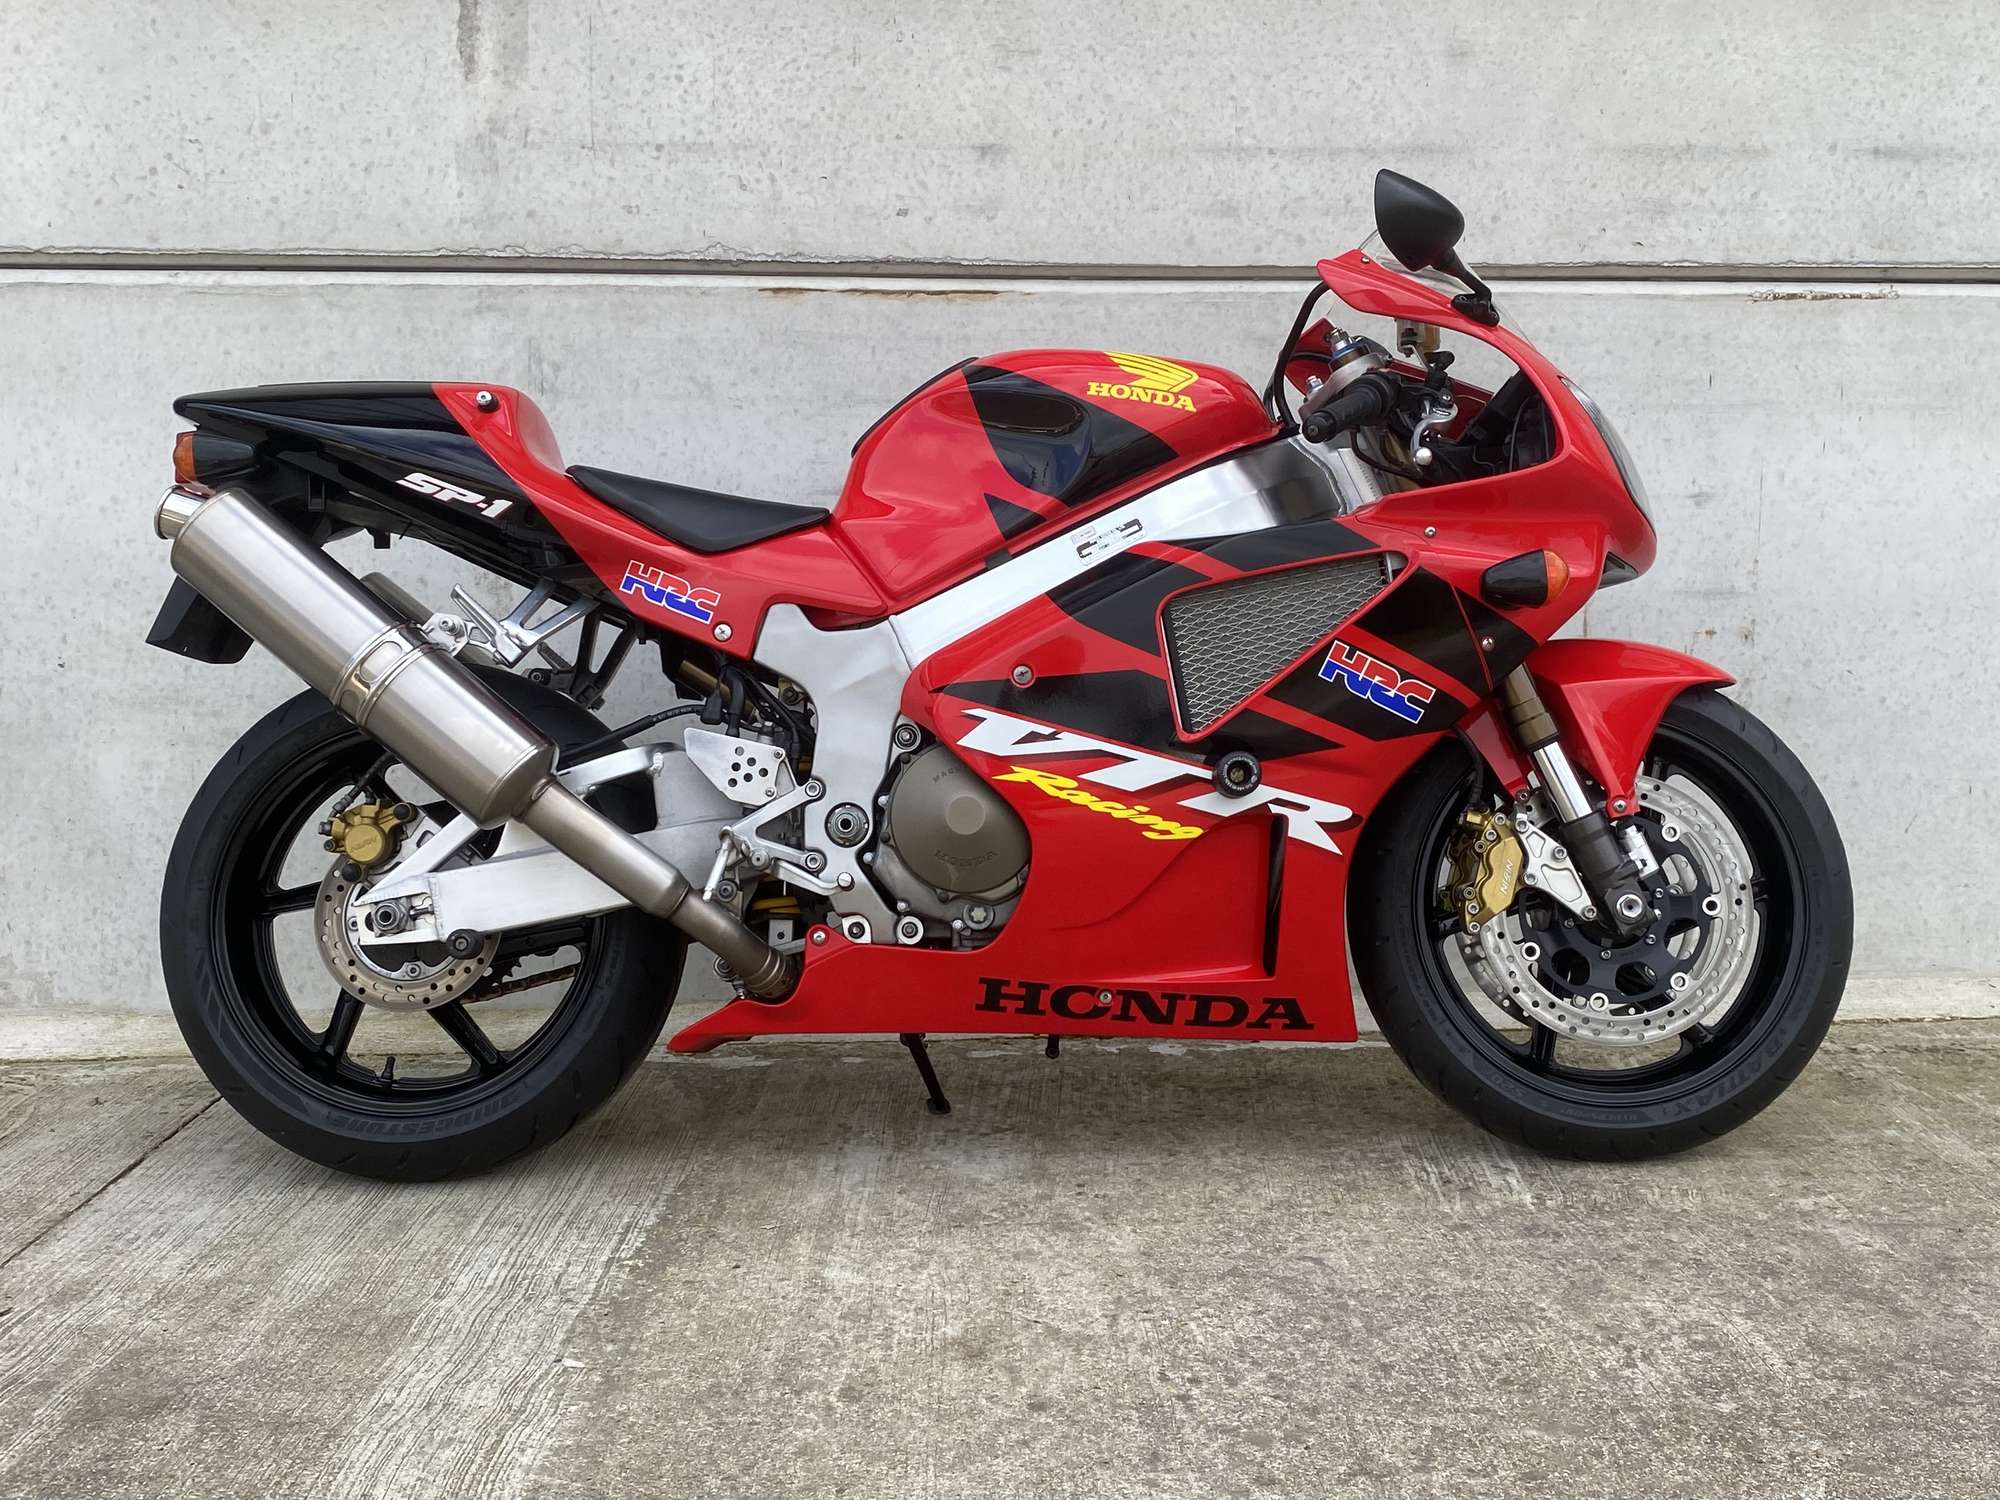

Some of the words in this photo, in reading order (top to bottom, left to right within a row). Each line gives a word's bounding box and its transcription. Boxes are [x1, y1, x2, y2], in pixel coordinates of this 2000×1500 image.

[1086, 381, 1198, 413] HONDA
[395, 472, 513, 518] SP-1
[619, 559, 722, 625] HRC
[1318, 639, 1437, 725] HRC
[956, 707, 1353, 856] VTR
[992, 765, 1205, 841] Racing
[975, 976, 1315, 1031] HONDA
